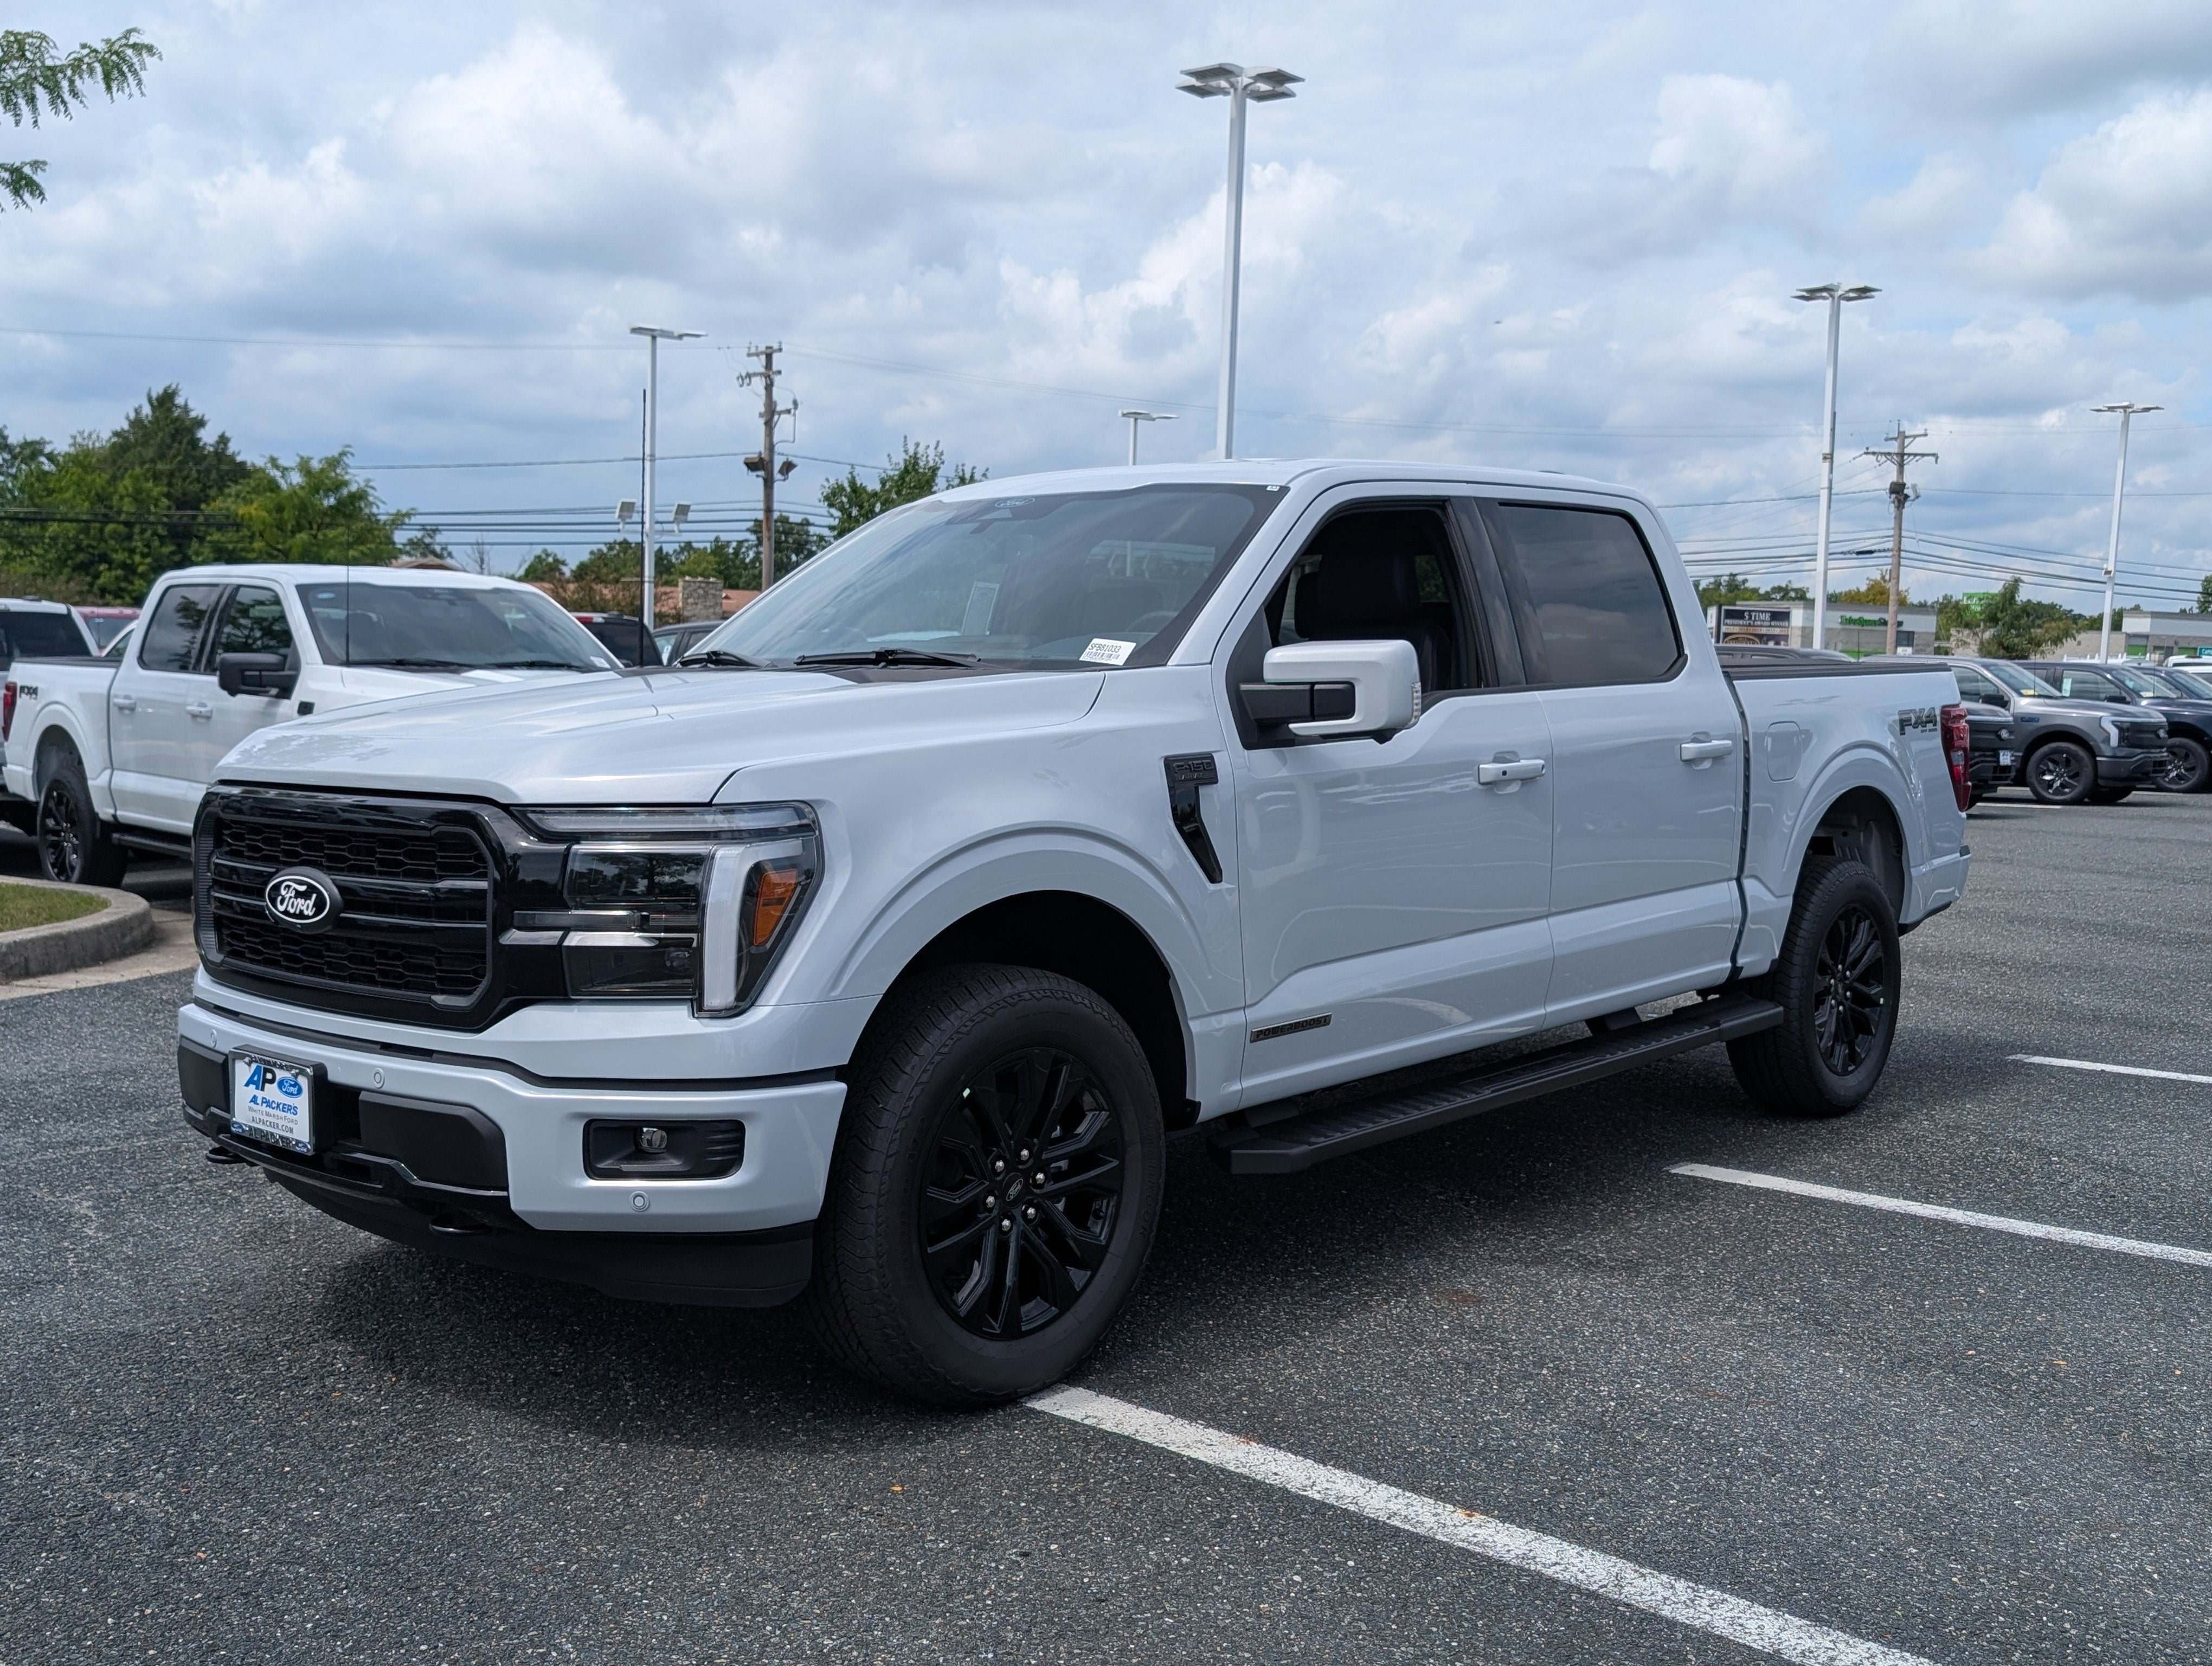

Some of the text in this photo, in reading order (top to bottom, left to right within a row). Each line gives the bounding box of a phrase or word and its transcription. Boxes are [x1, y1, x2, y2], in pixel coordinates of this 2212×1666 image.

[1751, 612, 1771, 621] TIME
[1898, 707, 1937, 735] FX4
[276, 881, 317, 917] Ford
[1255, 1016, 1329, 1039] POWERBOOST
[243, 1065, 299, 1095] AP Ford
[249, 1094, 299, 1116] AL PACKER'S
[252, 1116, 294, 1135] ALPACKER.COM
